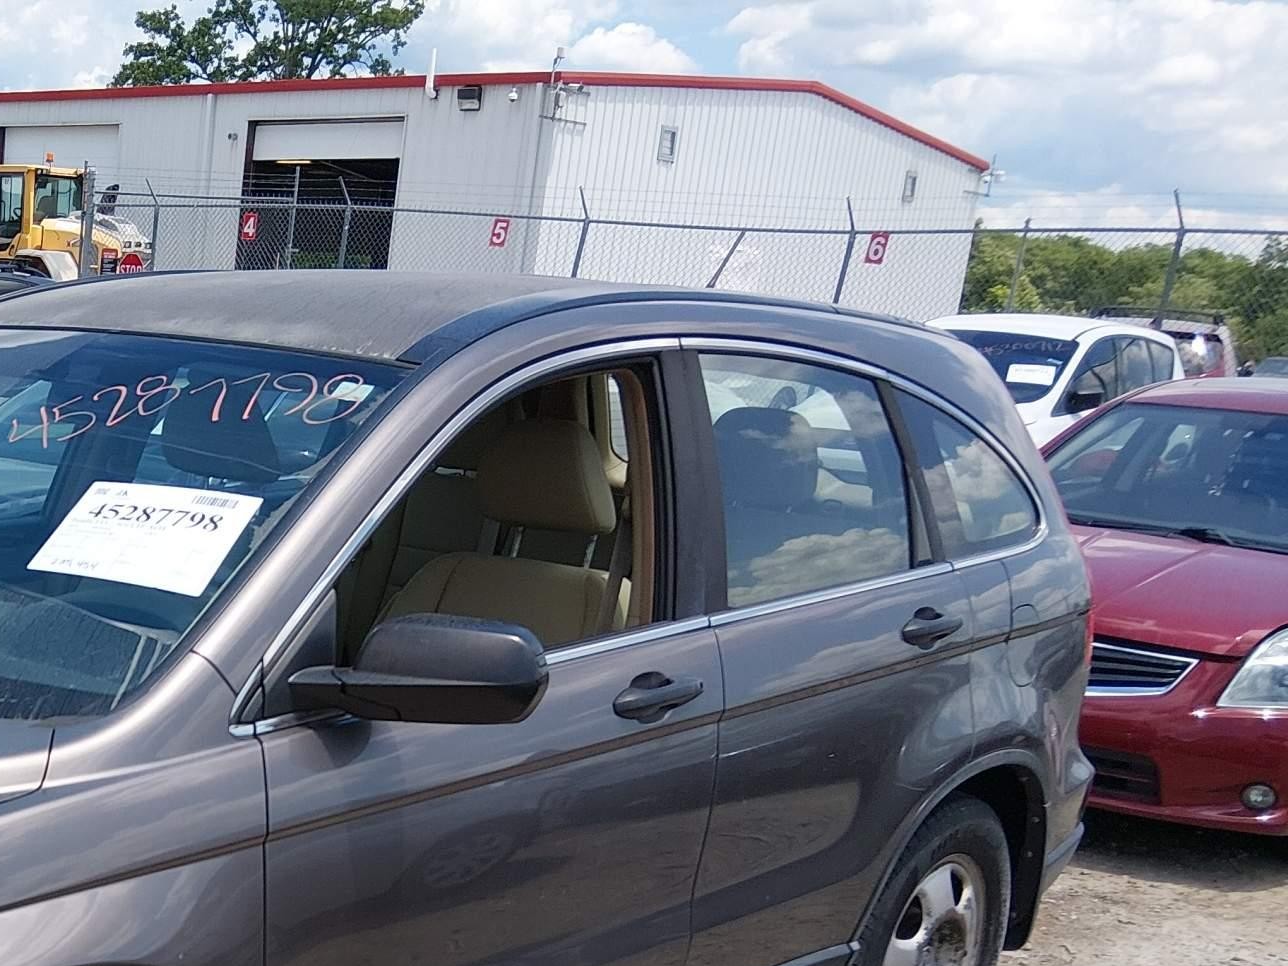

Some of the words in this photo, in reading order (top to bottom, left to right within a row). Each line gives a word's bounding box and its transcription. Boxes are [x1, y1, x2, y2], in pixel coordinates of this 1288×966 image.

[243, 216, 256, 237] 4
[492, 222, 508, 244] 5
[868, 236, 886, 261] 6
[8, 372, 365, 449] 45287798
[88, 502, 225, 533] 45287798
